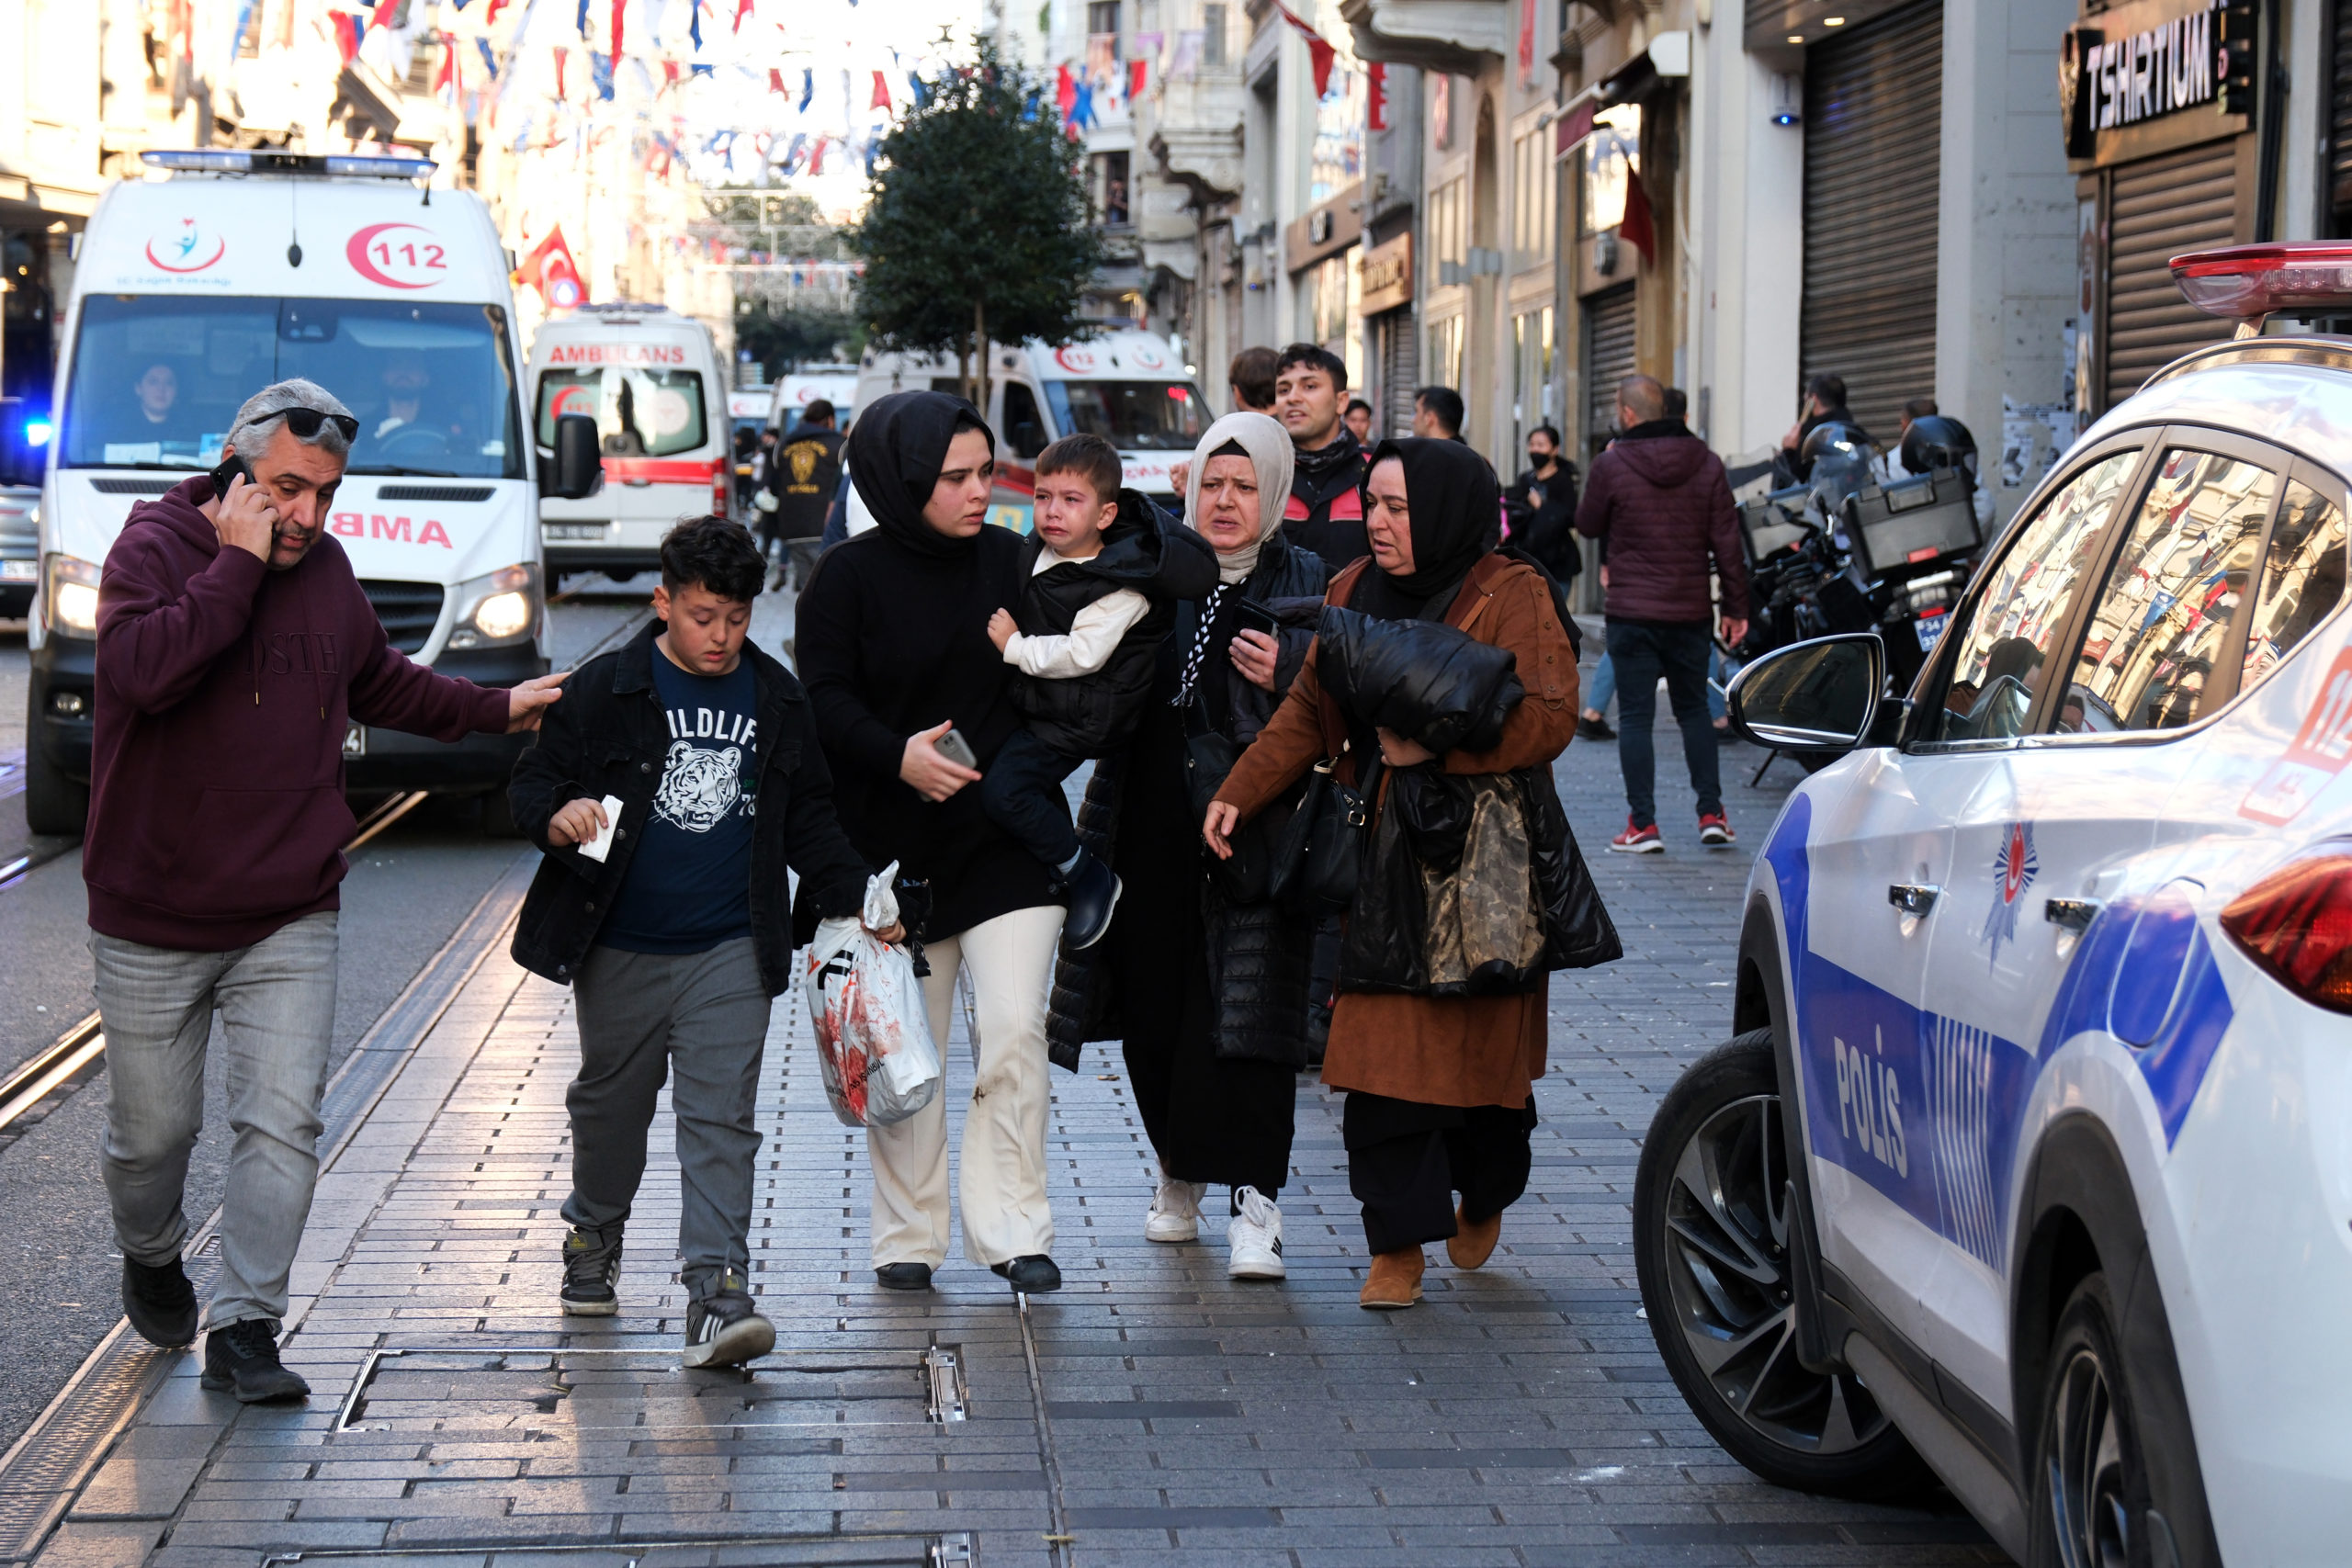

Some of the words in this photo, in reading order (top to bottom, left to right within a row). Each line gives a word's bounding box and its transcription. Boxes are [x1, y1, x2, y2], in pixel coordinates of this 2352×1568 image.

[2086, 7, 2211, 132] TSHIRTIUM
[373, 242, 447, 269] 112
[549, 344, 685, 365] AMBULANS
[665, 707, 757, 753] ILDLIF
[1834, 1023, 1908, 1179] POLİS
